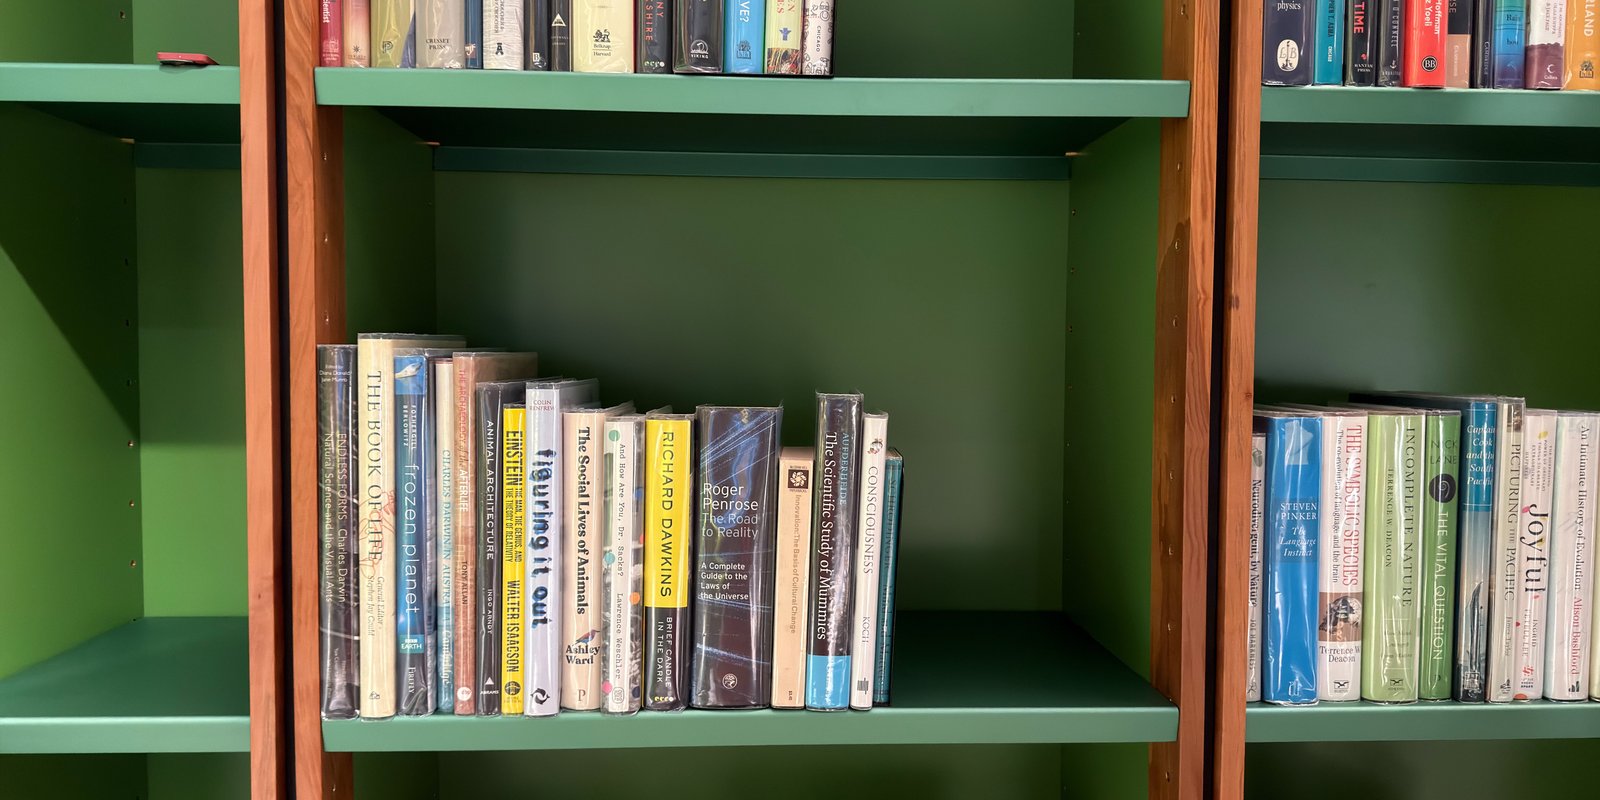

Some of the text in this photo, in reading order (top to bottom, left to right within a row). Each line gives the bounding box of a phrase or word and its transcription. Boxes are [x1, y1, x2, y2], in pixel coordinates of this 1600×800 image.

[1277, 0, 1301, 11] physics
[1353, 2, 1365, 34] TIME
[367, 371, 383, 561] THE BOOK OF LIFE
[442, 450, 451, 497] CHARLES
[505, 431, 523, 486] EINSTEIN
[618, 463, 626, 479] How
[840, 432, 849, 505] AUFDERHEIDE
[1430, 456, 1457, 465] LANE
[486, 421, 494, 560] ANIMAL ARCHITECTURE
[505, 488, 514, 496] THE
[703, 483, 744, 499] Roger
[1386, 469, 1394, 515] TERRENCE
[1507, 444, 1521, 523] PICTURING
[324, 433, 337, 603] Natural Science and the Visual Arts
[337, 432, 349, 603] ENDLESS FORMS Charles Darwin
[442, 501, 451, 546] DARWIN
[505, 500, 514, 522] THEORY
[577, 427, 590, 615] The Social Lives of Animals
[617, 502, 625, 521] You,
[660, 432, 674, 597] RICHARD DAWKINS
[702, 513, 759, 524] The Road
[703, 498, 759, 511] Penrose
[1250, 479, 1262, 559] Neurodivergent,
[1280, 502, 1317, 511] STEVEN
[1281, 512, 1317, 520] PINKER
[1342, 425, 1362, 586] THE SYMBOLIC SPECIES
[1386, 518, 1392, 528] W.
[1402, 428, 1415, 607] INCOMPLETE NATURE
[402, 464, 420, 613] frozen planet
[514, 488, 522, 562] THE MAN, THE GENIUS, AND
[529, 449, 557, 629] figuring it out
[702, 526, 759, 540] to Reality
[793, 534, 801, 547] The
[817, 432, 838, 640] The Scientific Study of Mummies
[442, 549, 451, 561] IN
[505, 531, 513, 562] RELATIVITY
[861, 467, 879, 643] CONSCIOUSNESS KOCH
[1519, 504, 1549, 592] Joyful
[1571, 426, 1590, 675] An Intimate History of Evolution Alison Bashford
[701, 572, 723, 580] Guide
[735, 572, 748, 580] the
[709, 562, 746, 571] Complete
[792, 569, 800, 577] of
[1250, 561, 1260, 571] by
[1504, 547, 1517, 601] PACIFIC
[377, 577, 385, 625] General Editor
[506, 580, 520, 622] WALTER
[700, 592, 713, 600] the
[701, 582, 731, 590] Laws of
[791, 577, 799, 605] Cultural
[1248, 575, 1260, 607] Nature
[1432, 512, 1448, 660] THE VITAL QUESTION
[367, 576, 375, 636] Stephen Jay Gould
[790, 606, 798, 634] Change
[657, 622, 664, 631] IN
[441, 630, 453, 685] Cambridge
[506, 623, 520, 673] ISAACSON
[566, 645, 600, 656] Ashley
[566, 655, 594, 664] Ward
[615, 638, 623, 680] Weschler
[1249, 635, 1257, 670] HARKNESS
